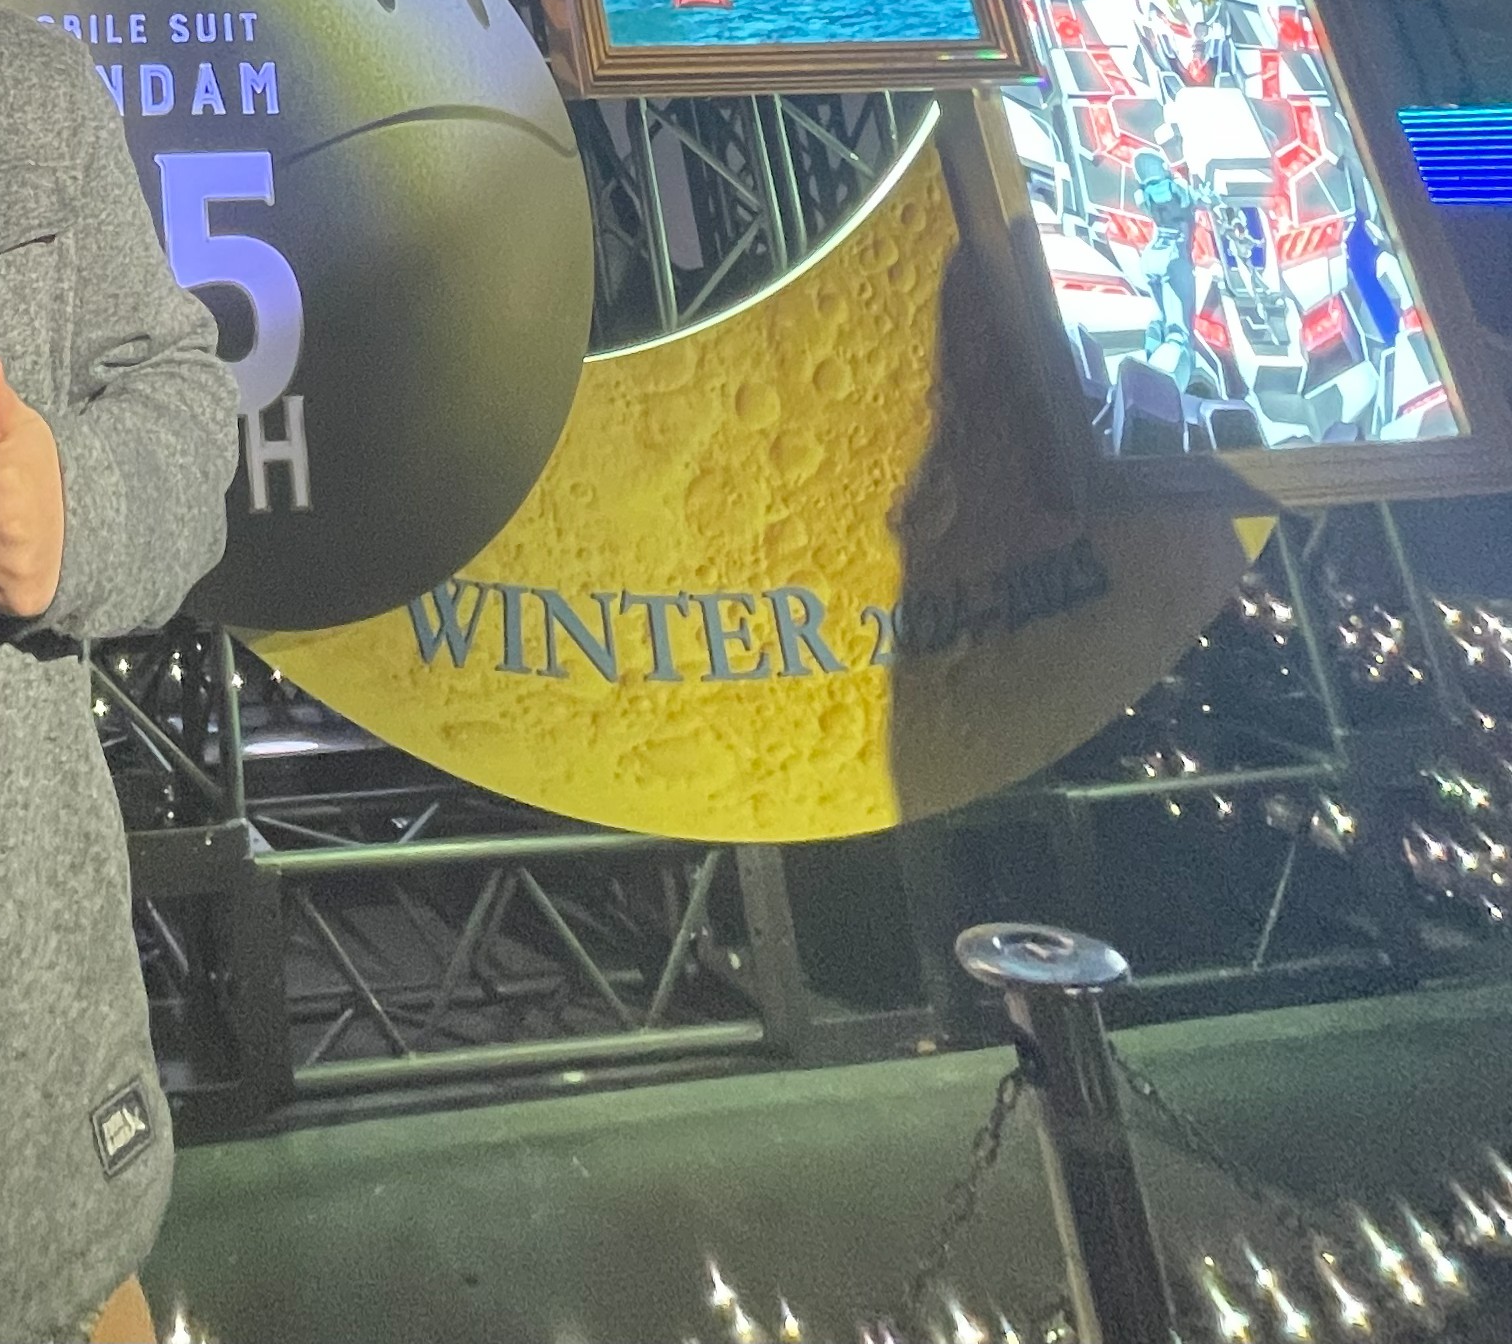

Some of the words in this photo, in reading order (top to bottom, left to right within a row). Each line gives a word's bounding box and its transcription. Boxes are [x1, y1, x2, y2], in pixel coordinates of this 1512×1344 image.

[36, 13, 148, 44] BILE
[168, 12, 257, 43] SUIT
[153, 150, 305, 415] 5
[406, 577, 846, 683] WINTER
